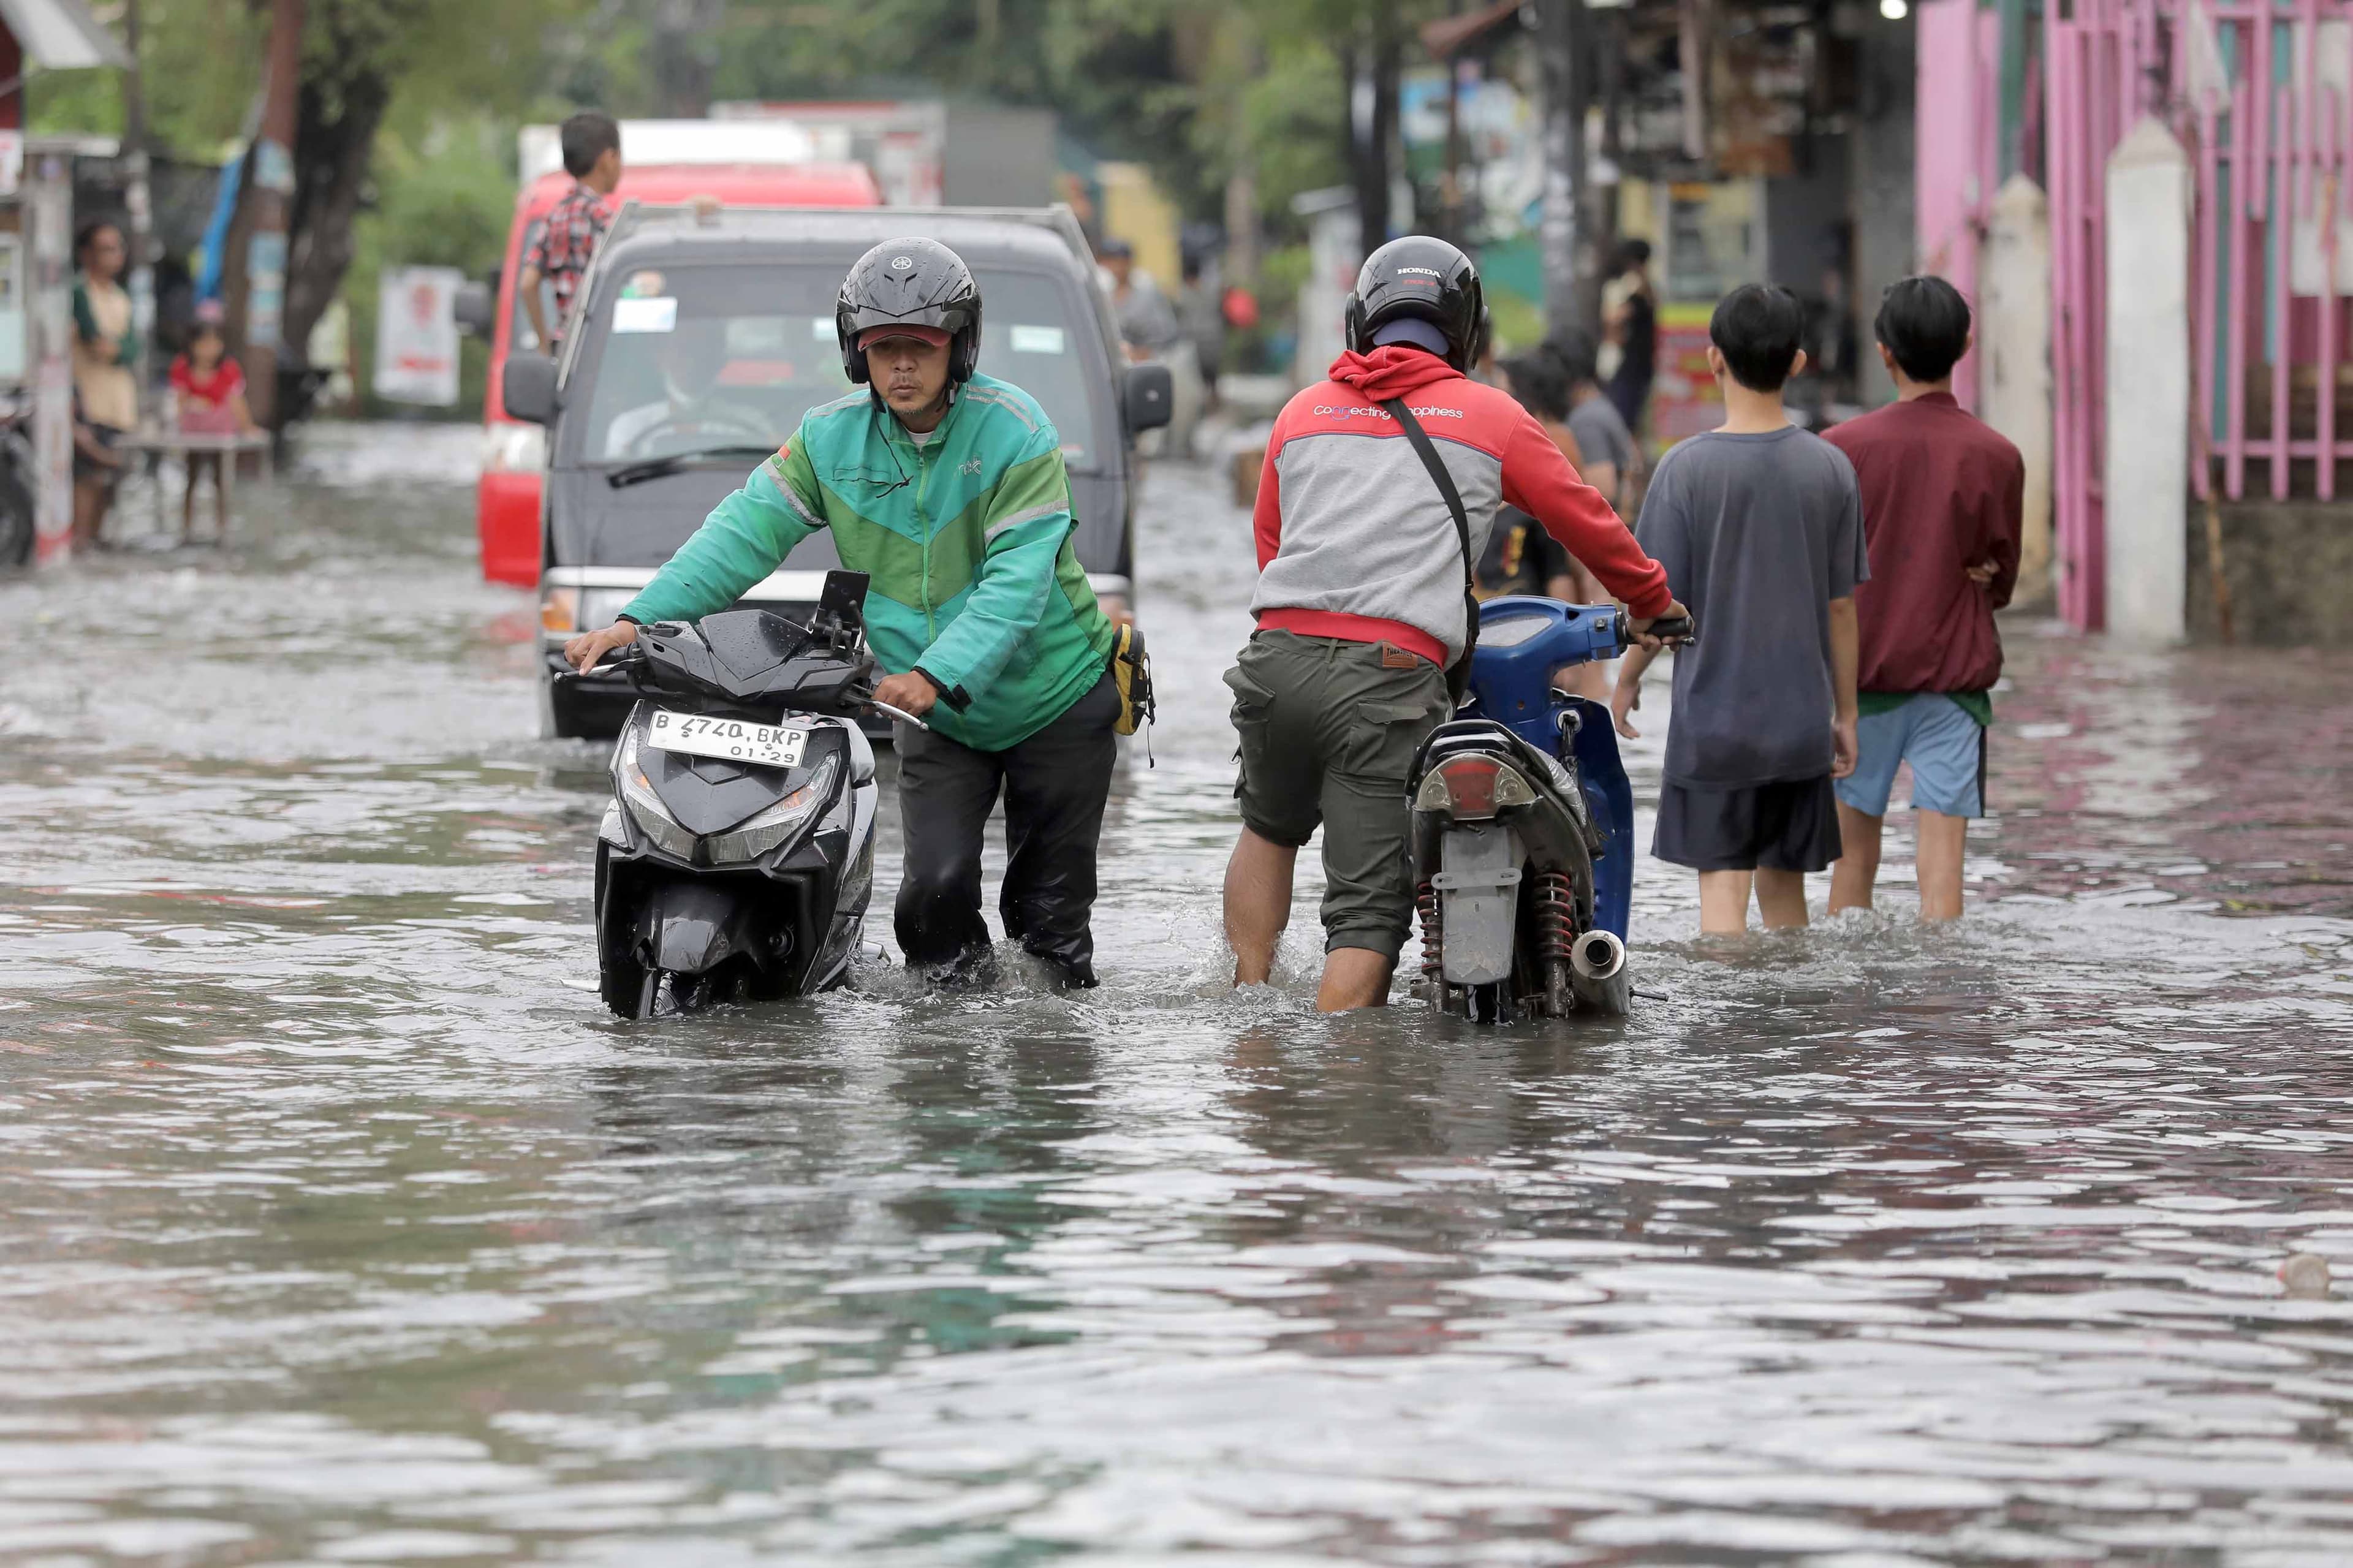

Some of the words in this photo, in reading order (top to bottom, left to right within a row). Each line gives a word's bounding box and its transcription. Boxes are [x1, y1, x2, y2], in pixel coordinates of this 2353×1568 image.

[1397, 267, 1441, 278] HONDA
[1313, 404, 1391, 420] Connecting
[656, 714, 669, 728] B
[681, 718, 743, 738] 4740
[757, 728, 801, 746] BKP
